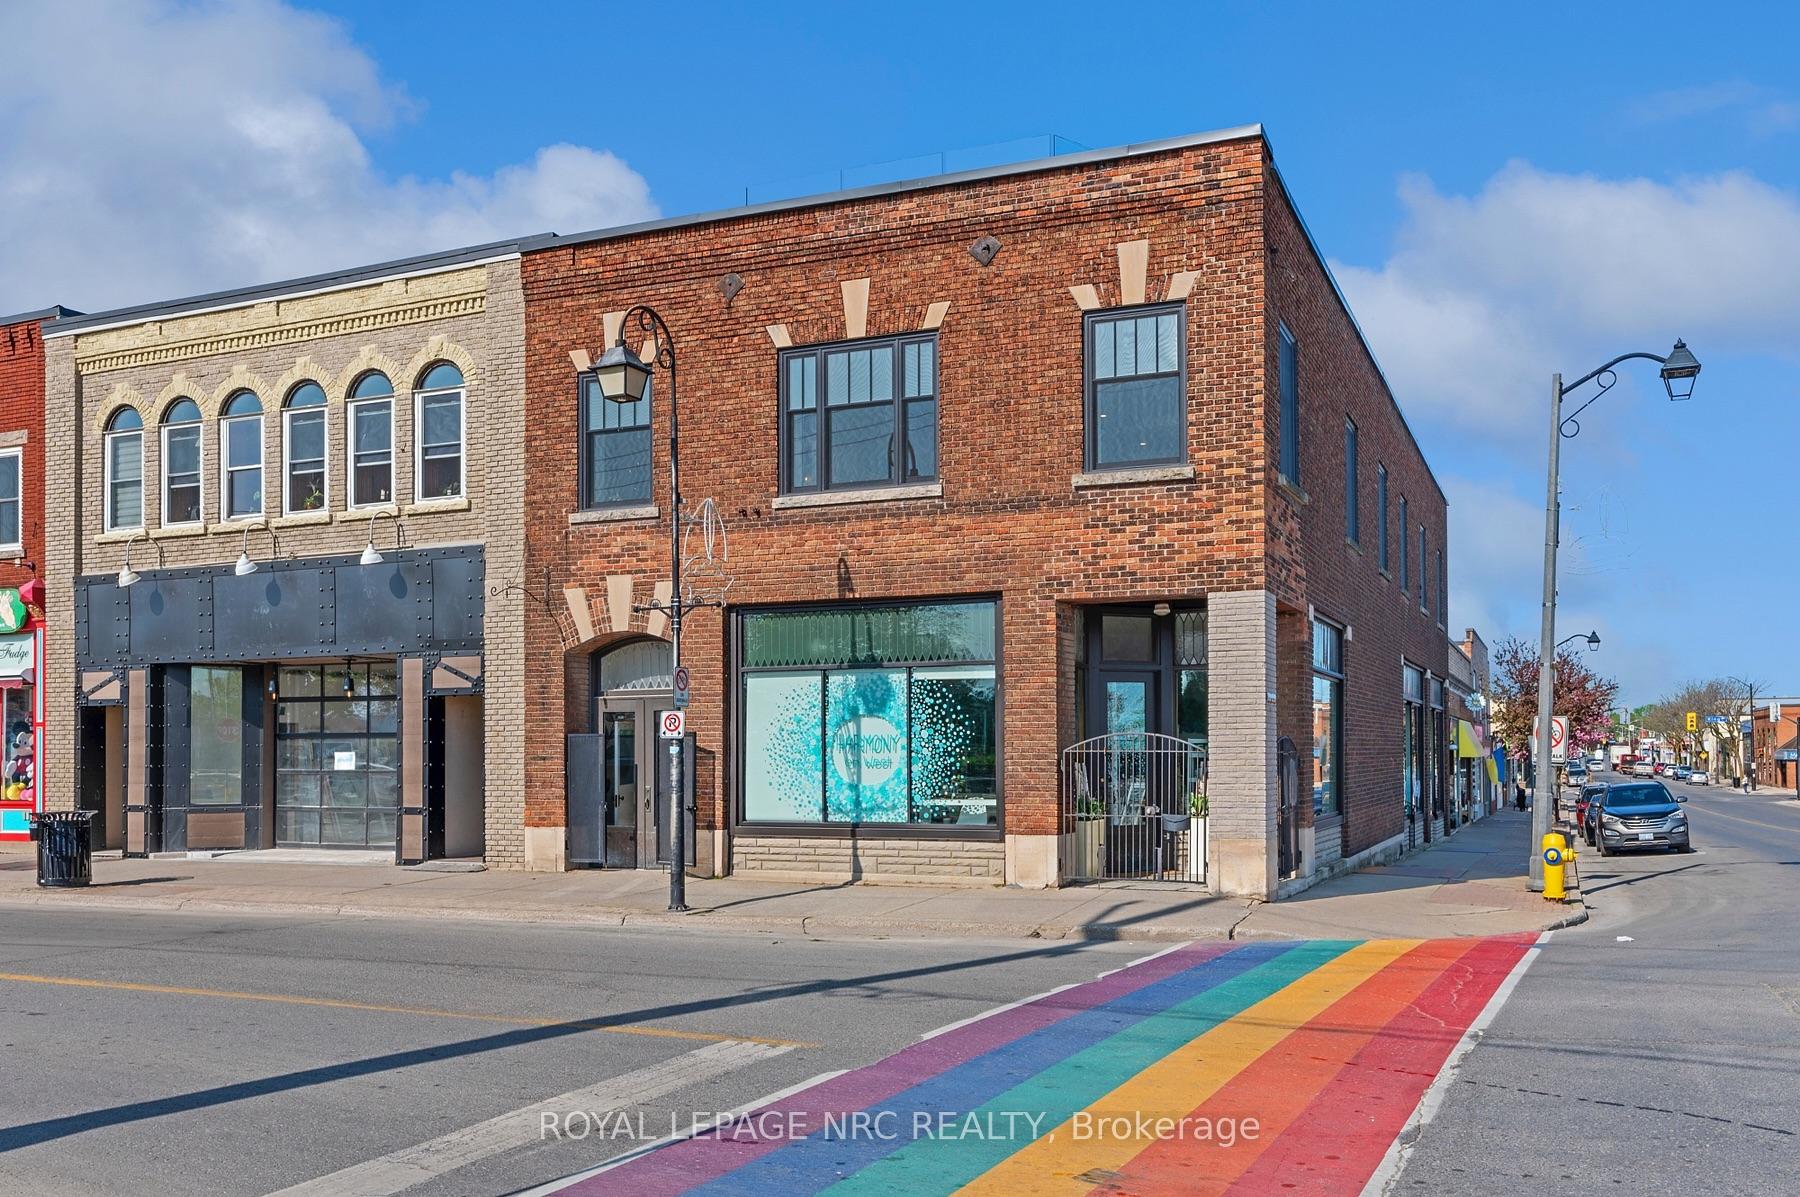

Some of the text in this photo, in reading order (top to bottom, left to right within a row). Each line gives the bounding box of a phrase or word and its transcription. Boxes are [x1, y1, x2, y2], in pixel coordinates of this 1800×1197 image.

[0, 643, 29, 664] Fudge
[838, 734, 900, 754] HARMONY
[863, 755, 893, 769] West
